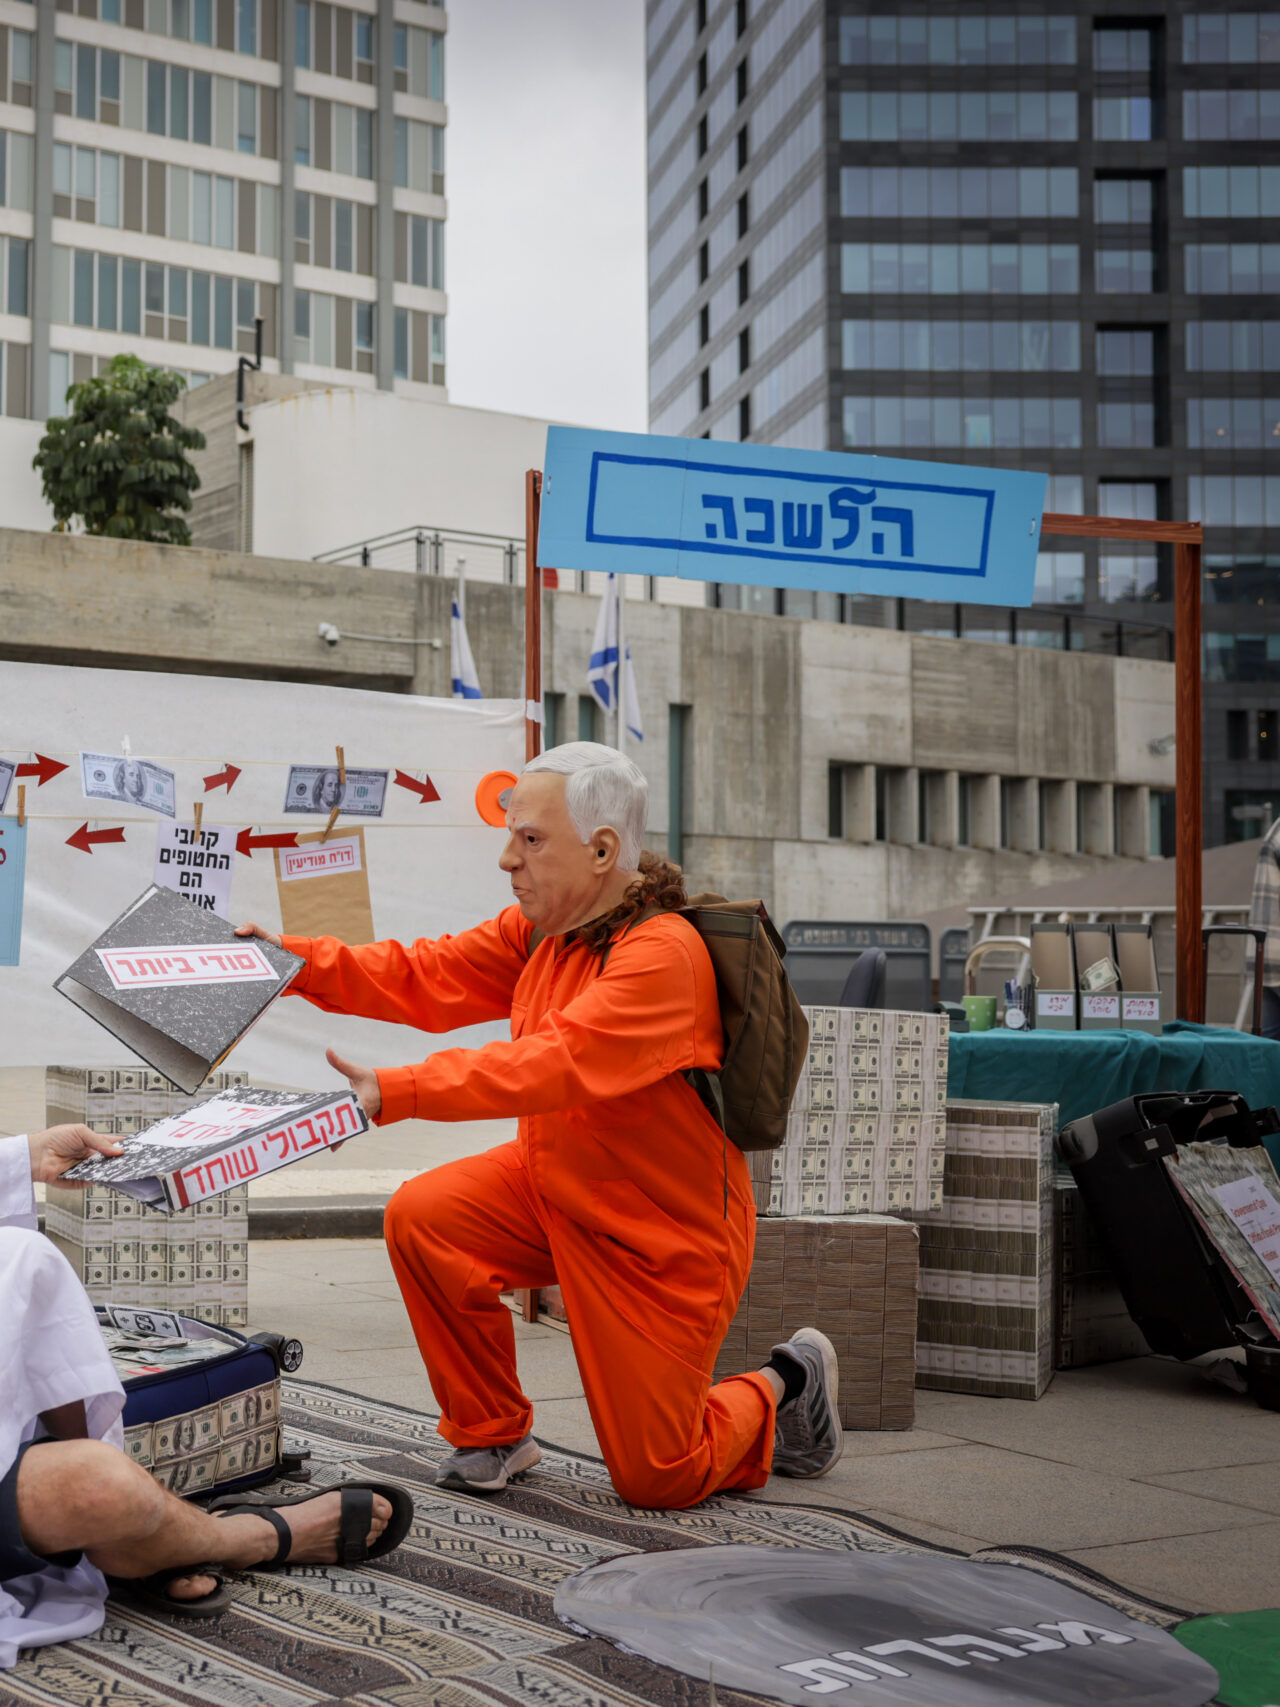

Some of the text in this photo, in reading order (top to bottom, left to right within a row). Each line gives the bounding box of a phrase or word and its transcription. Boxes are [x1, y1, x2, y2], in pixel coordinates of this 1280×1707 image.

[701, 486, 914, 557] הלשכה
[159, 848, 230, 870] החטופים
[288, 854, 326, 873] מודיעין
[179, 871, 203, 889] הם
[116, 953, 257, 977] סודי ביותר
[184, 1103, 358, 1194] תקבולי שוחד
[776, 1620, 1136, 1694] מנהרות
